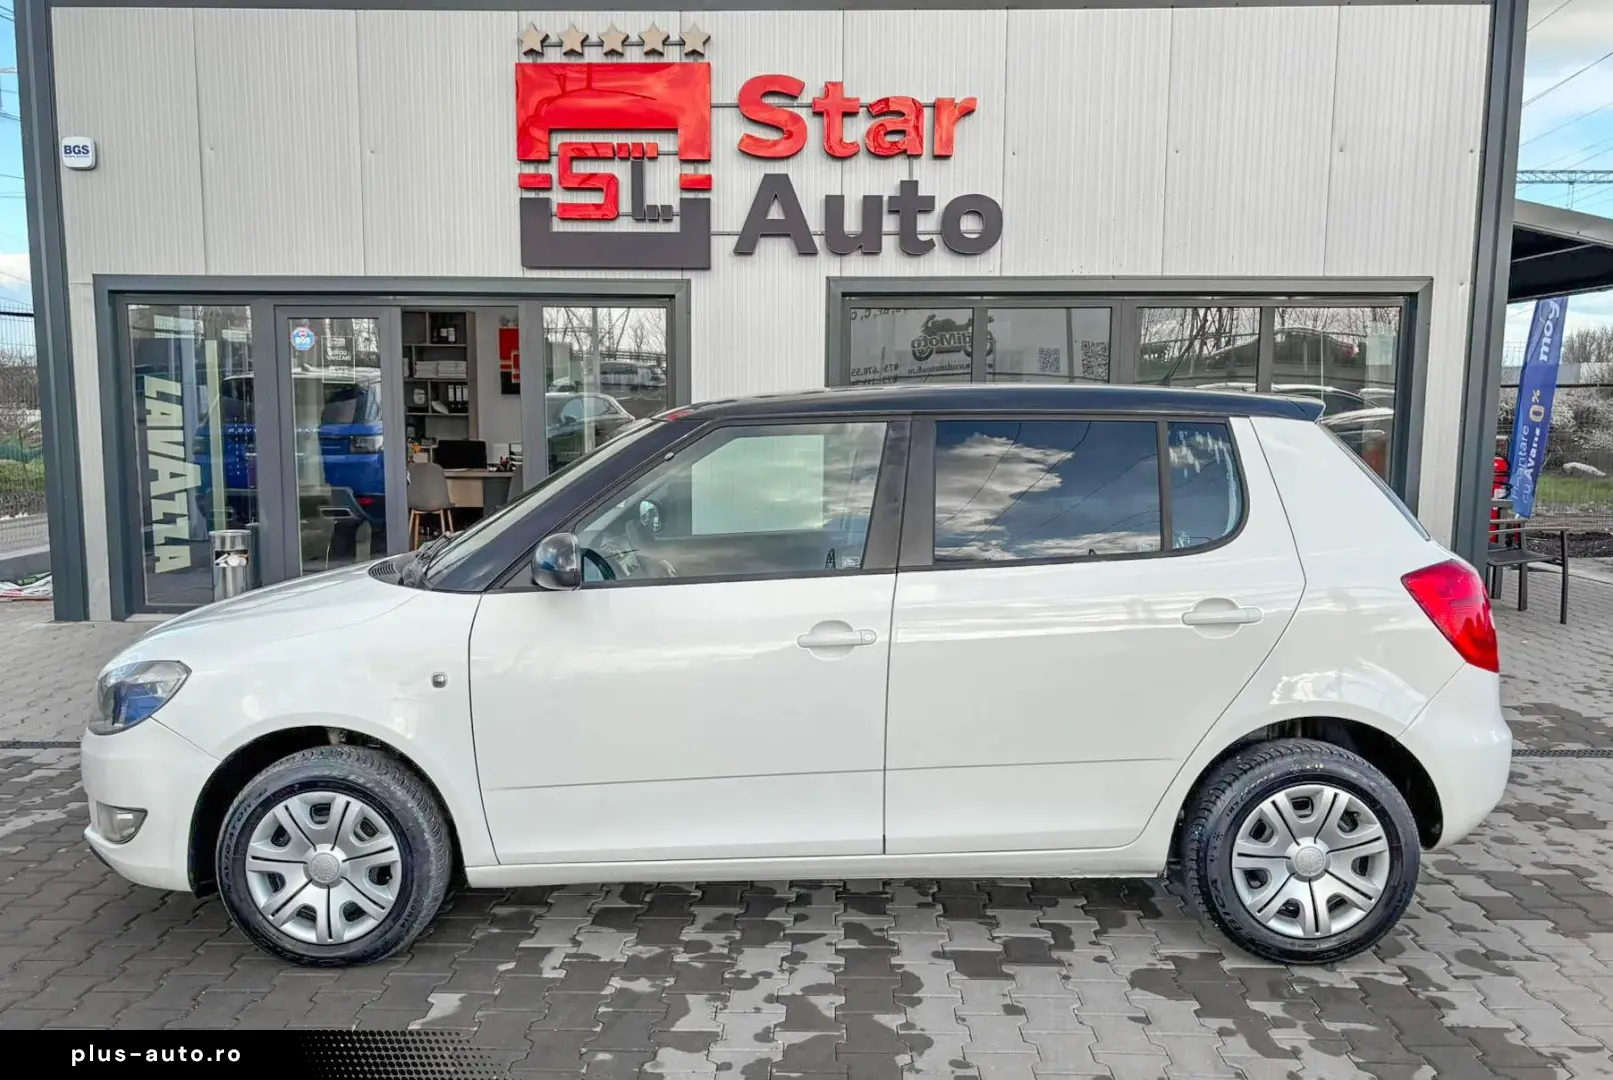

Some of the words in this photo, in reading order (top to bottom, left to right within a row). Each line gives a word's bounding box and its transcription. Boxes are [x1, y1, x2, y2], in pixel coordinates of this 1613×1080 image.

[63, 144, 90, 155] BGS
[737, 74, 978, 158] Star
[733, 172, 1003, 255] Auto
[144, 375, 202, 574] LAVAZZA
